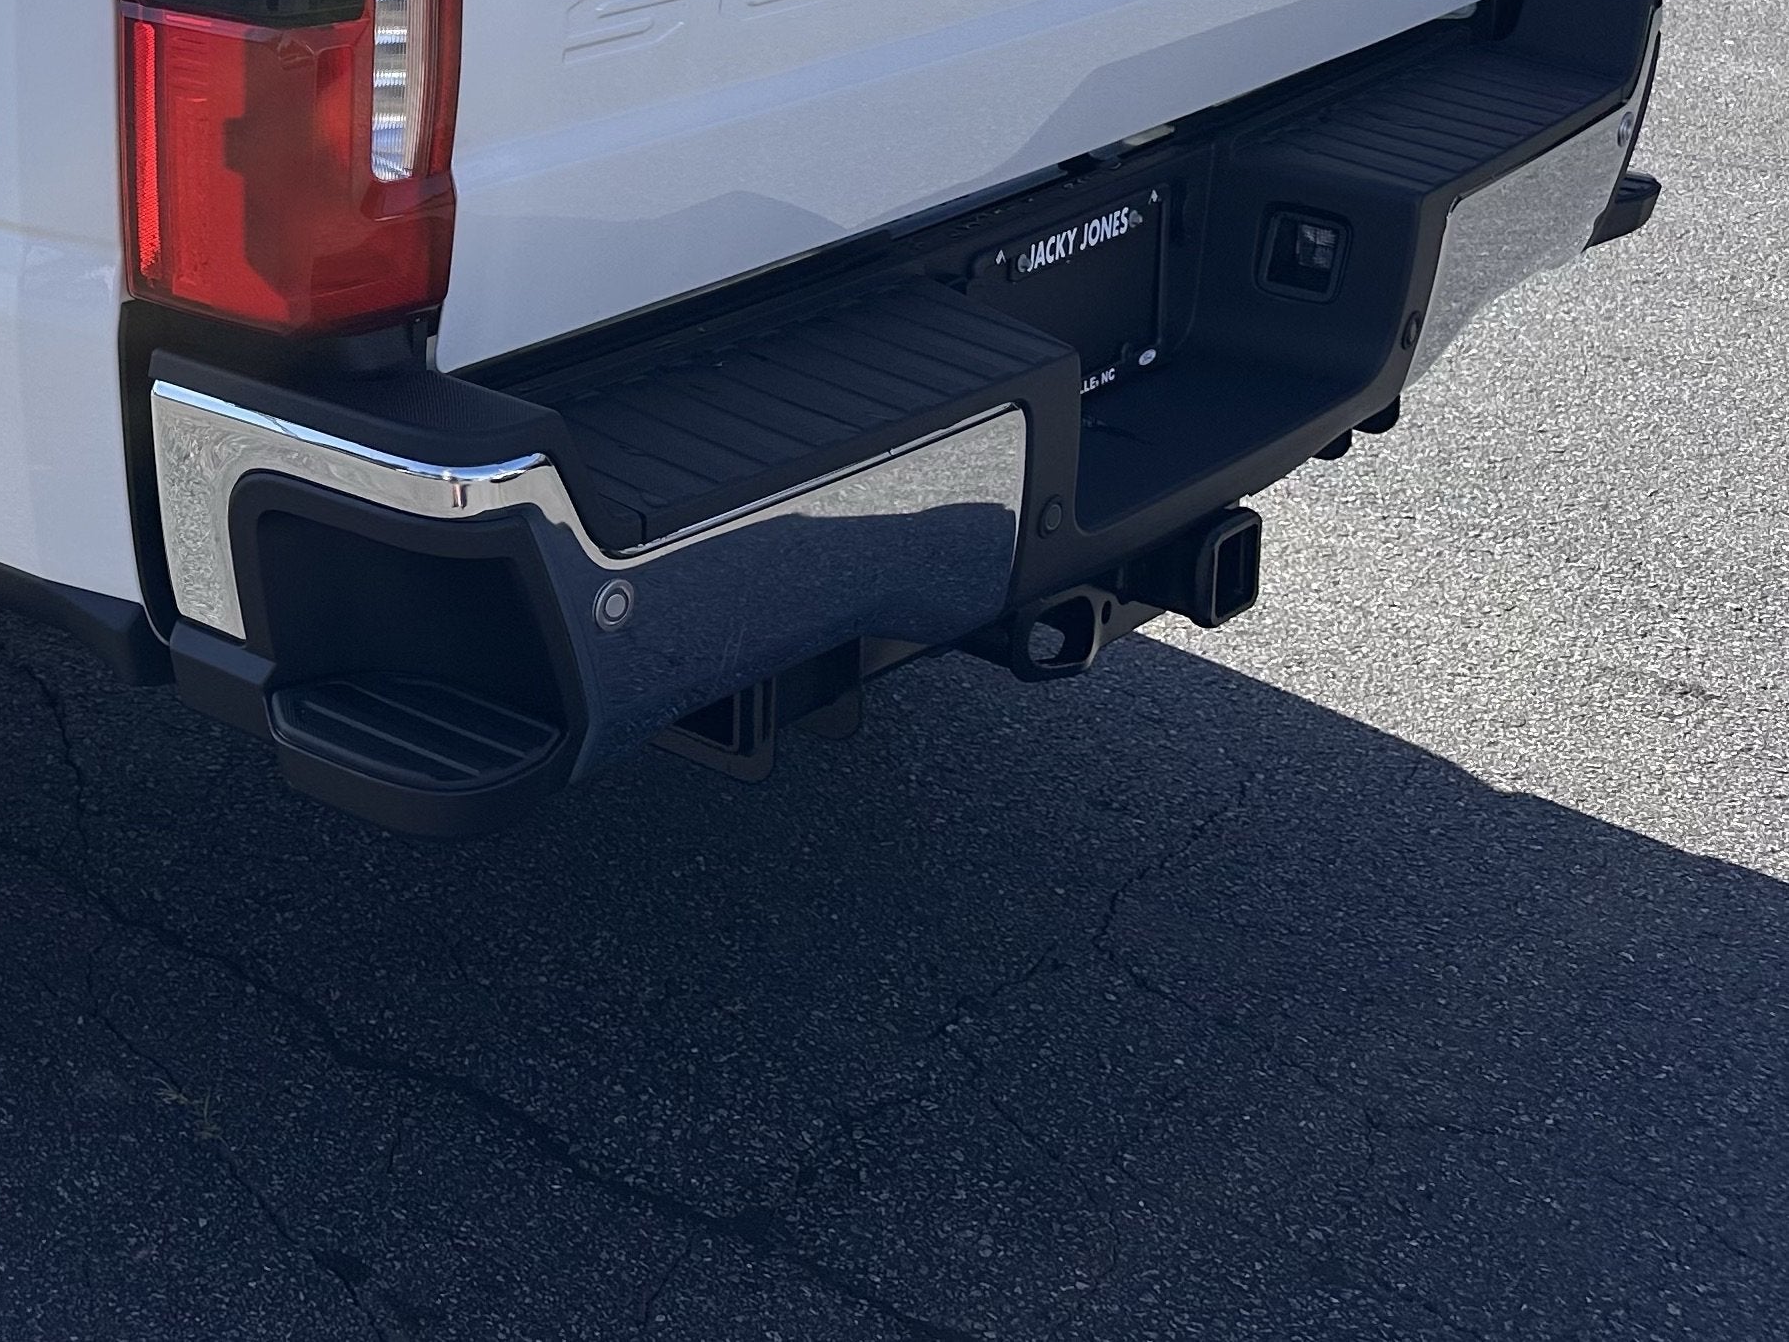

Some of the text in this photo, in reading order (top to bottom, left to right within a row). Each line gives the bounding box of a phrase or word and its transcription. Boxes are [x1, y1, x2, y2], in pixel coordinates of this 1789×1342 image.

[1026, 227, 1078, 272] JACKY
[1080, 207, 1130, 251] JONES
[1101, 368, 1115, 385] NC
